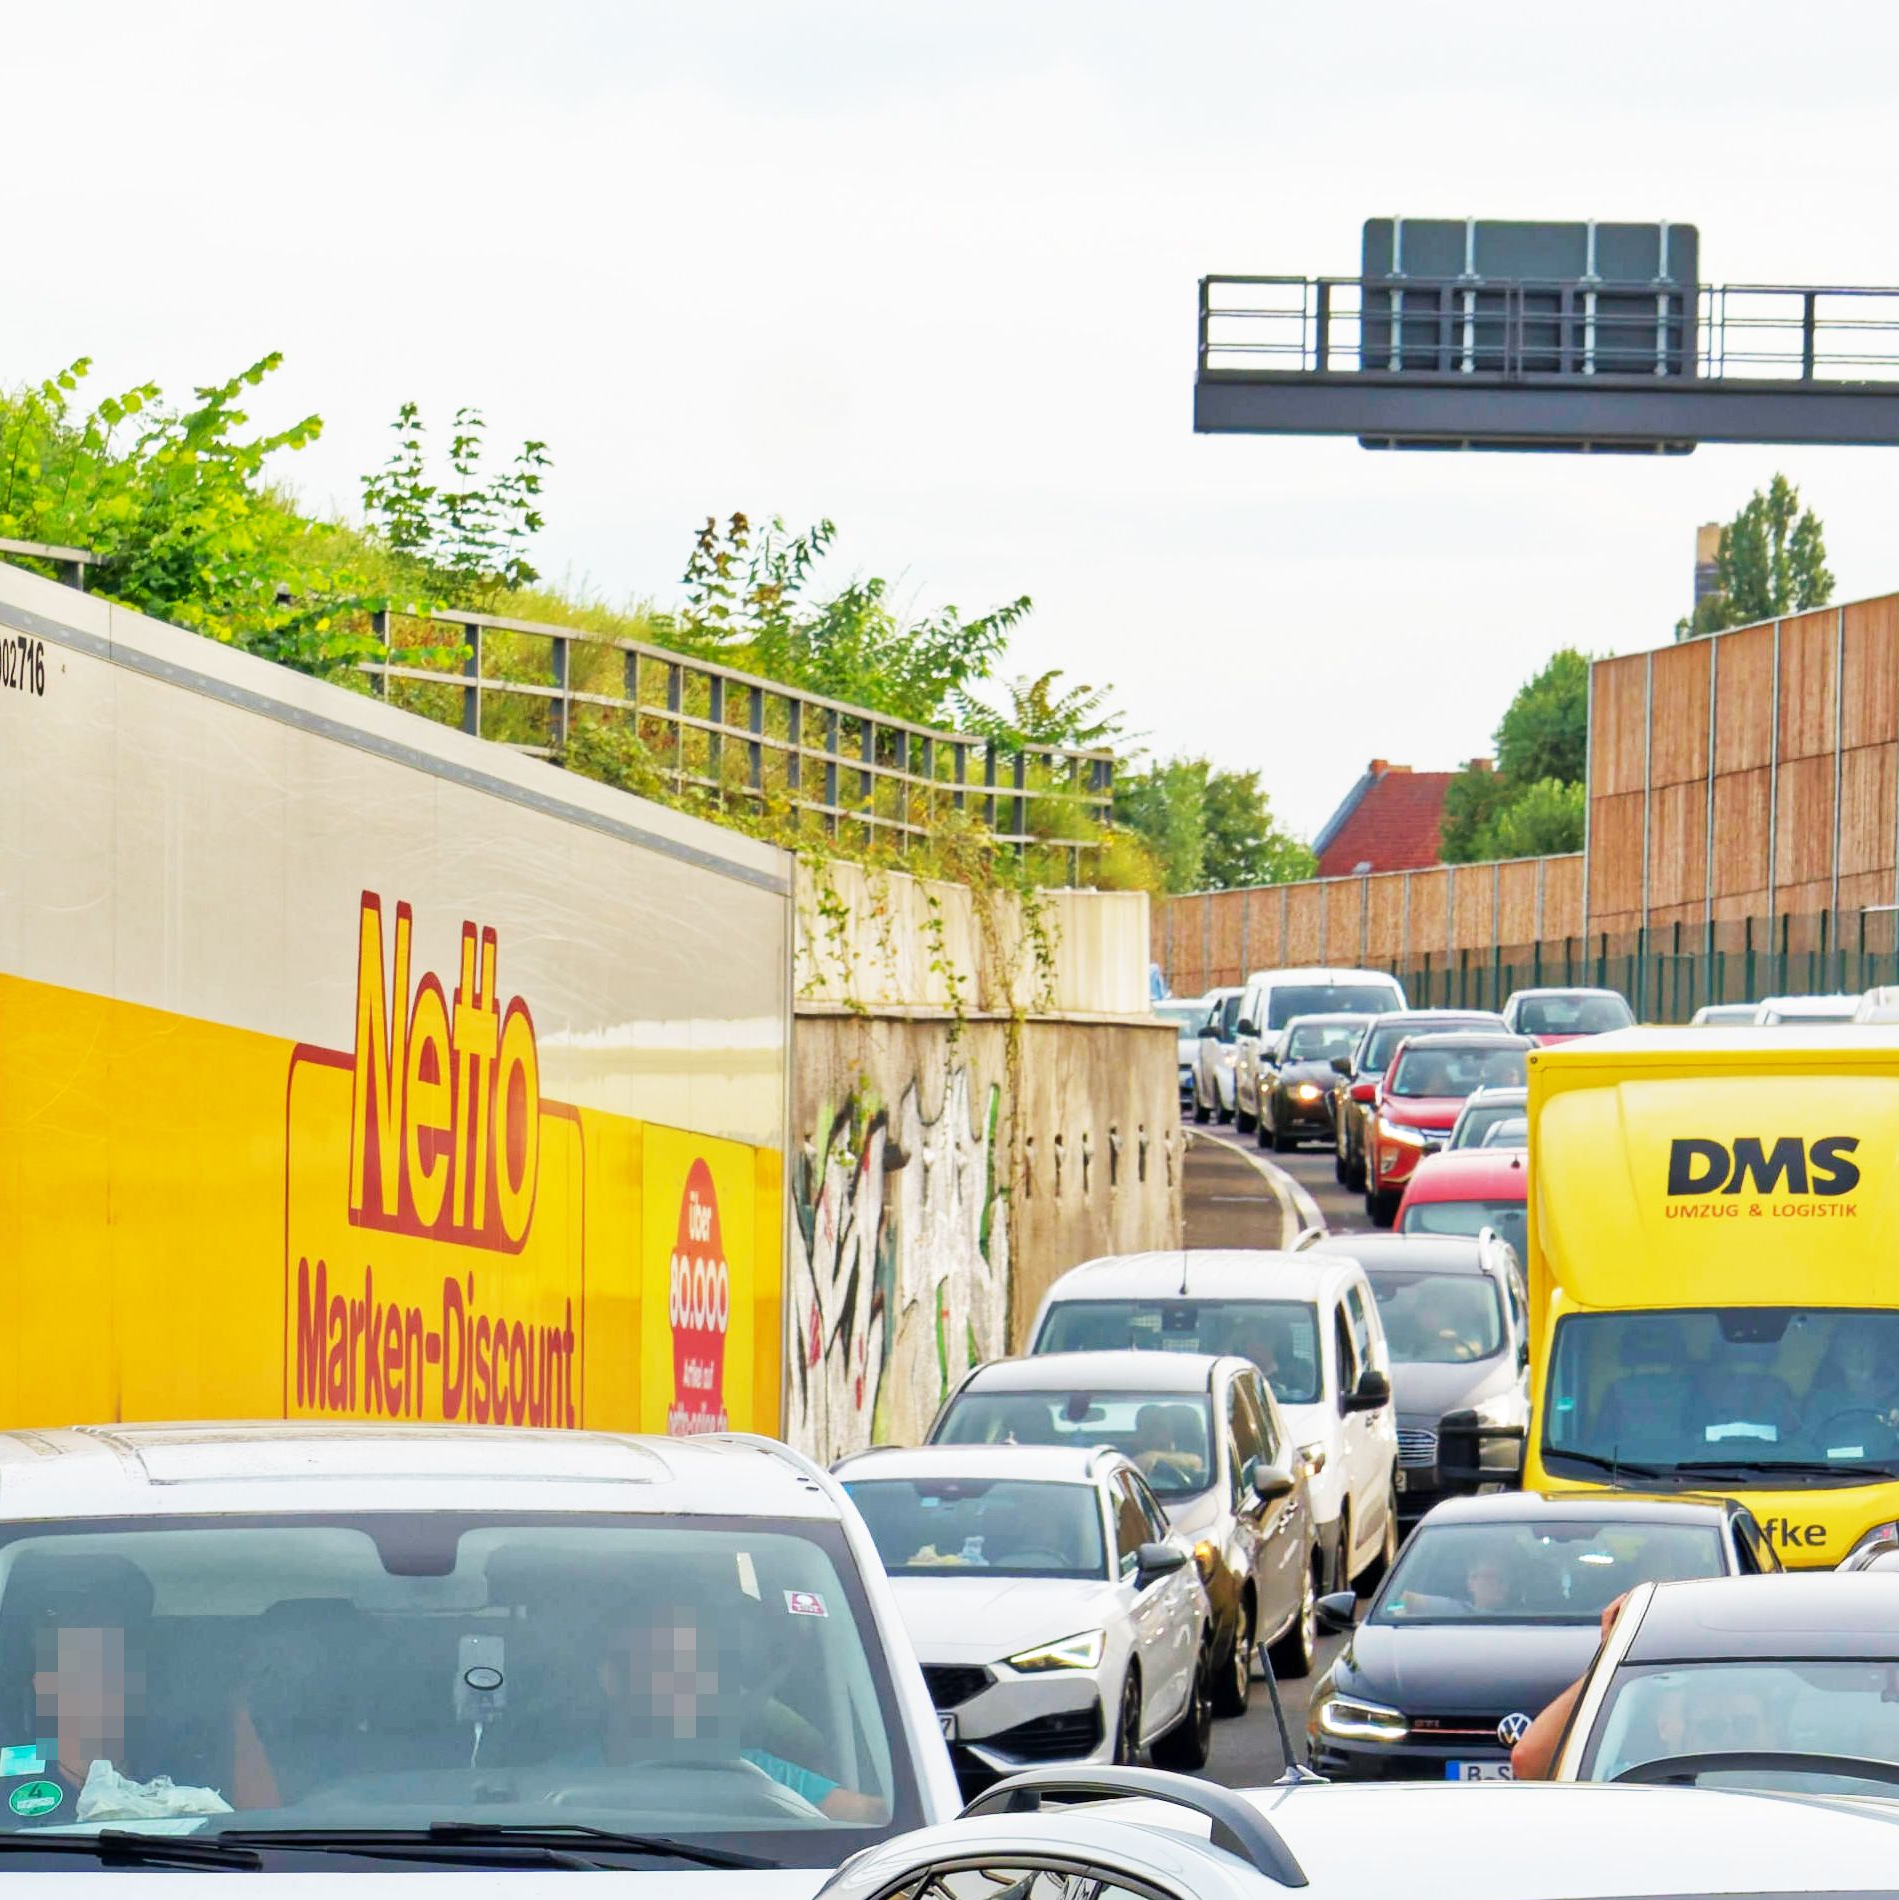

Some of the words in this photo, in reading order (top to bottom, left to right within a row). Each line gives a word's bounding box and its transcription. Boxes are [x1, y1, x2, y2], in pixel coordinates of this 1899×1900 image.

[348, 889, 540, 1256] Netto
[1667, 1136, 1860, 1196] DMS
[688, 1190, 712, 1242] über
[1665, 1204, 1739, 1219] UMZUG
[1748, 1203, 1763, 1217] &
[1772, 1203, 1858, 1217] LOGISTIK
[669, 1252, 729, 1334] 80.000
[296, 1256, 576, 1430] Marken-Discount
